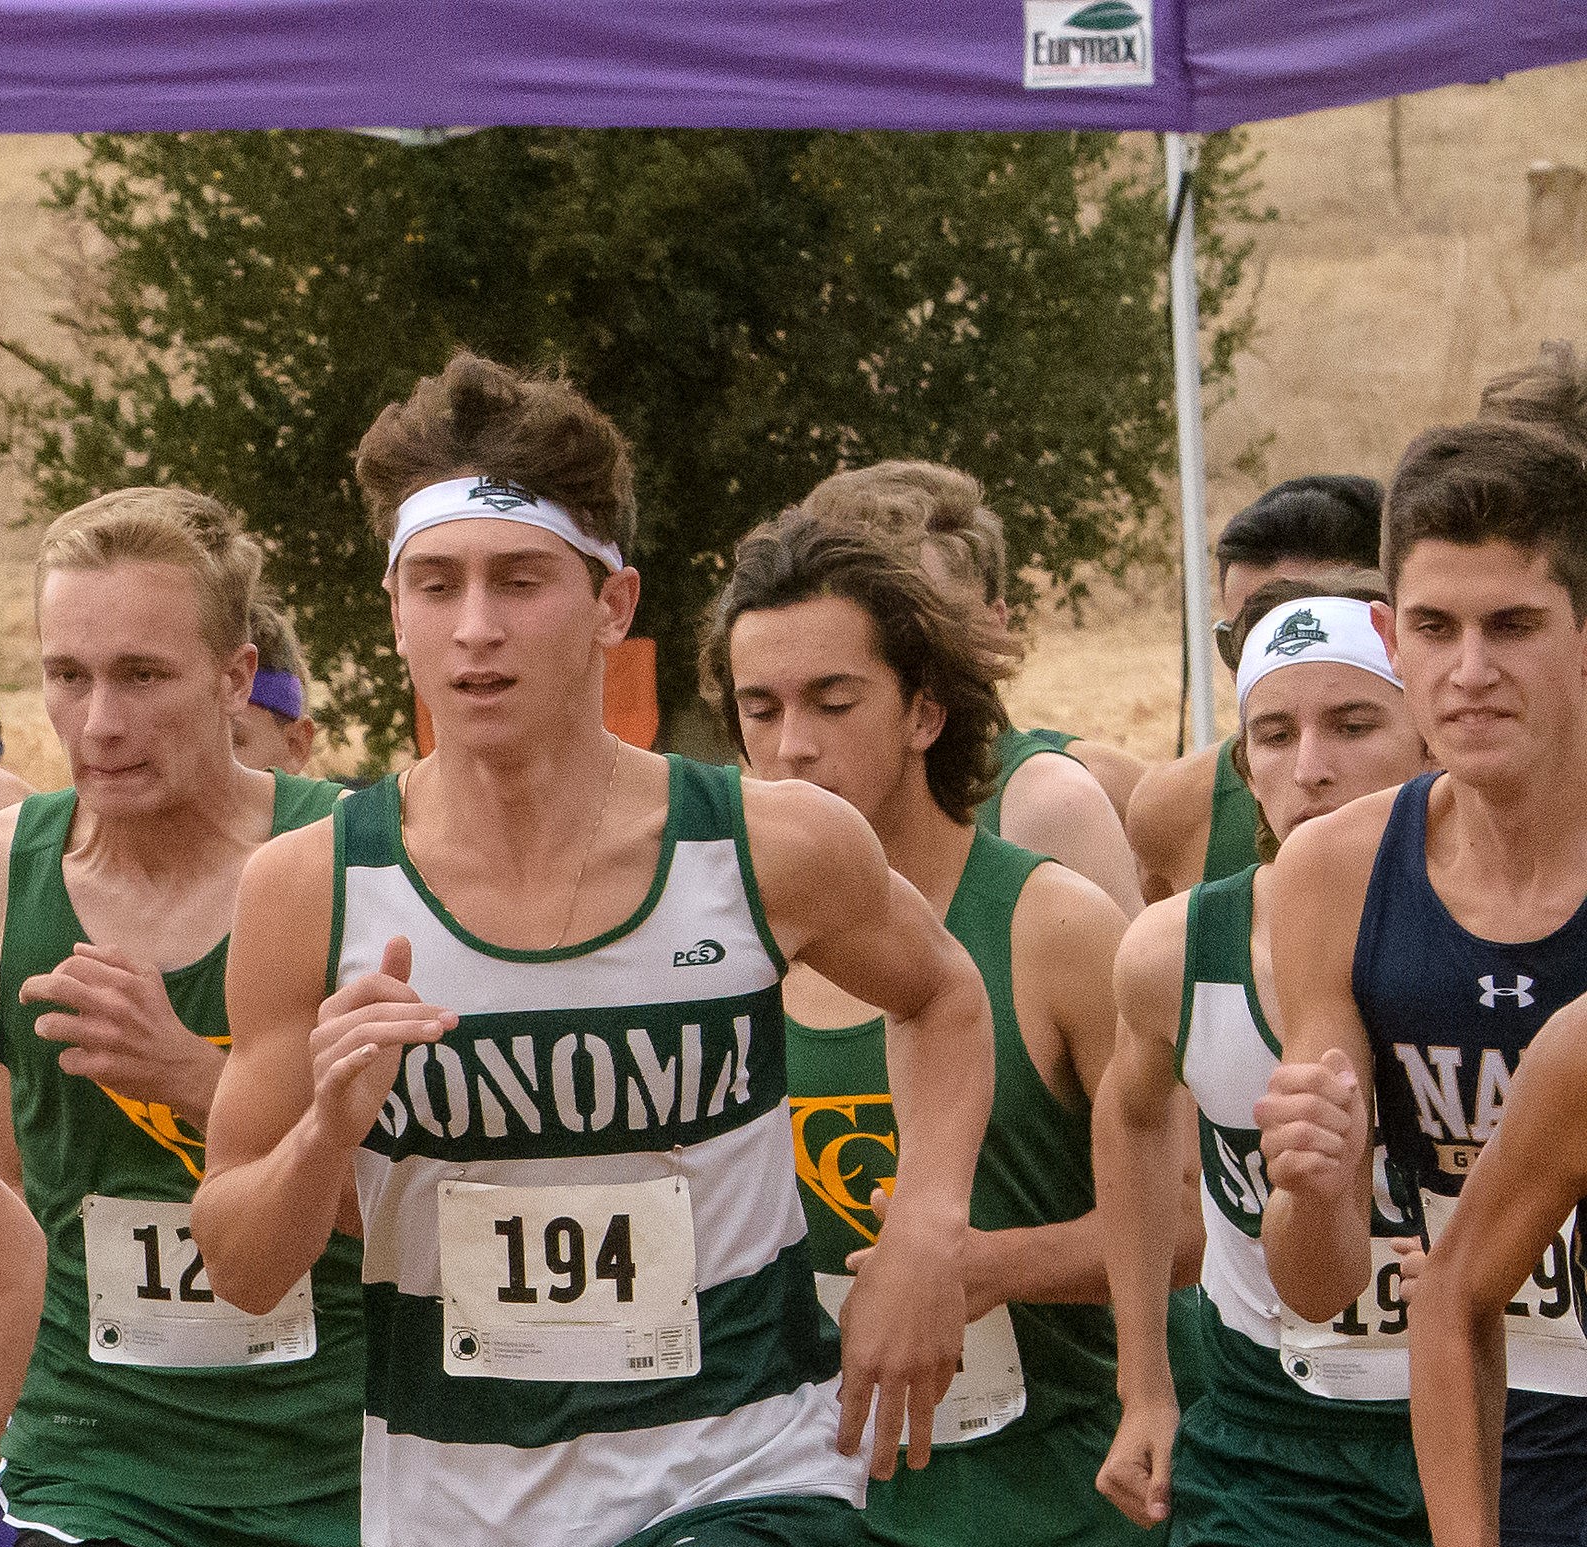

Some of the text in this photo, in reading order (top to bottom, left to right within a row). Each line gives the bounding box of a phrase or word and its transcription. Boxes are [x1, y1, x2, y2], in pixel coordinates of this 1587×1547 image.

[1033, 31, 1138, 65] Eurmax
[1393, 1042, 1517, 1141] NA
[133, 1224, 215, 1303] 12
[494, 1213, 637, 1304] 194
[1332, 1262, 1410, 1336] 19
